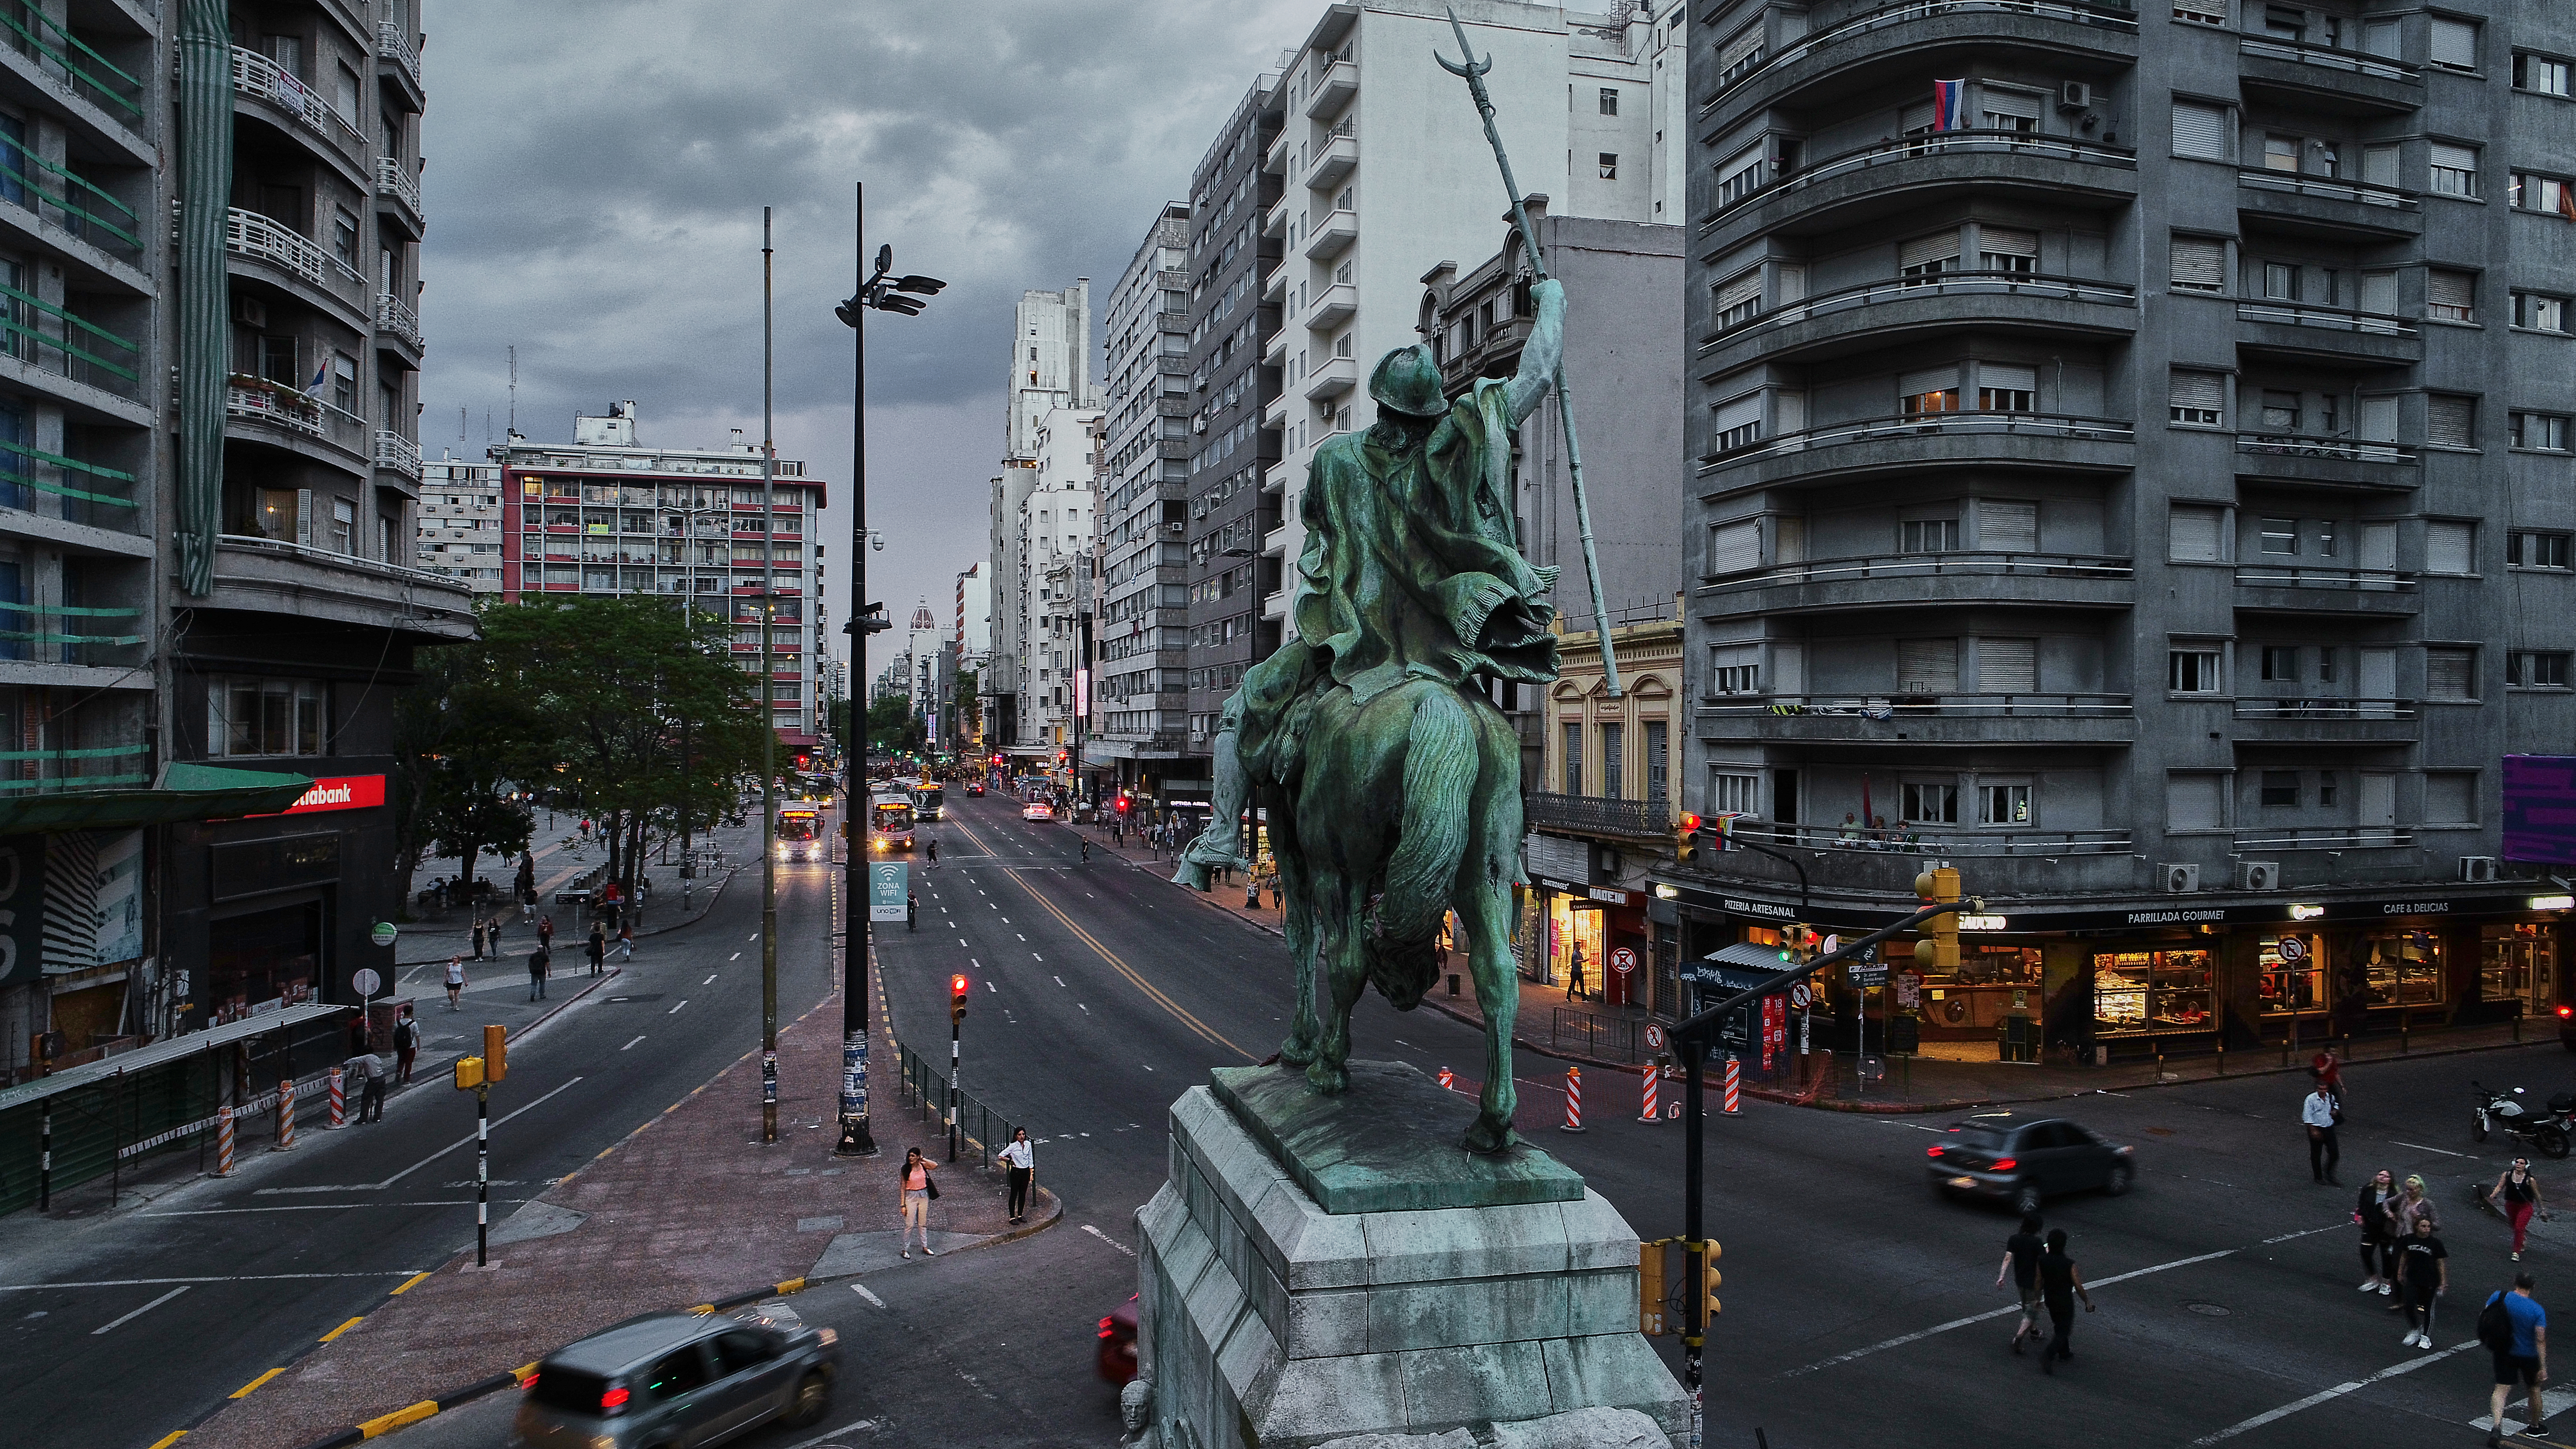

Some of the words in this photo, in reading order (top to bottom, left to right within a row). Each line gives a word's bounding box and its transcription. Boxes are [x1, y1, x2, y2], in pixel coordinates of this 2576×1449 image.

[284, 74, 300, 91] VENDE
[292, 783, 351, 806] tiabank
[1542, 879, 1567, 890] CUATROASES
[1725, 899, 1750, 912] PIZZERIA
[1752, 903, 1795, 918] ARTESANAL
[2384, 905, 2405, 913] CAFE
[2407, 904, 2412, 913] &
[2414, 903, 2448, 912] DELICIAS
[2128, 912, 2180, 923] PARRILLADA
[2182, 910, 2225, 921] GOURMET
[1774, 998, 1782, 1009] 18
